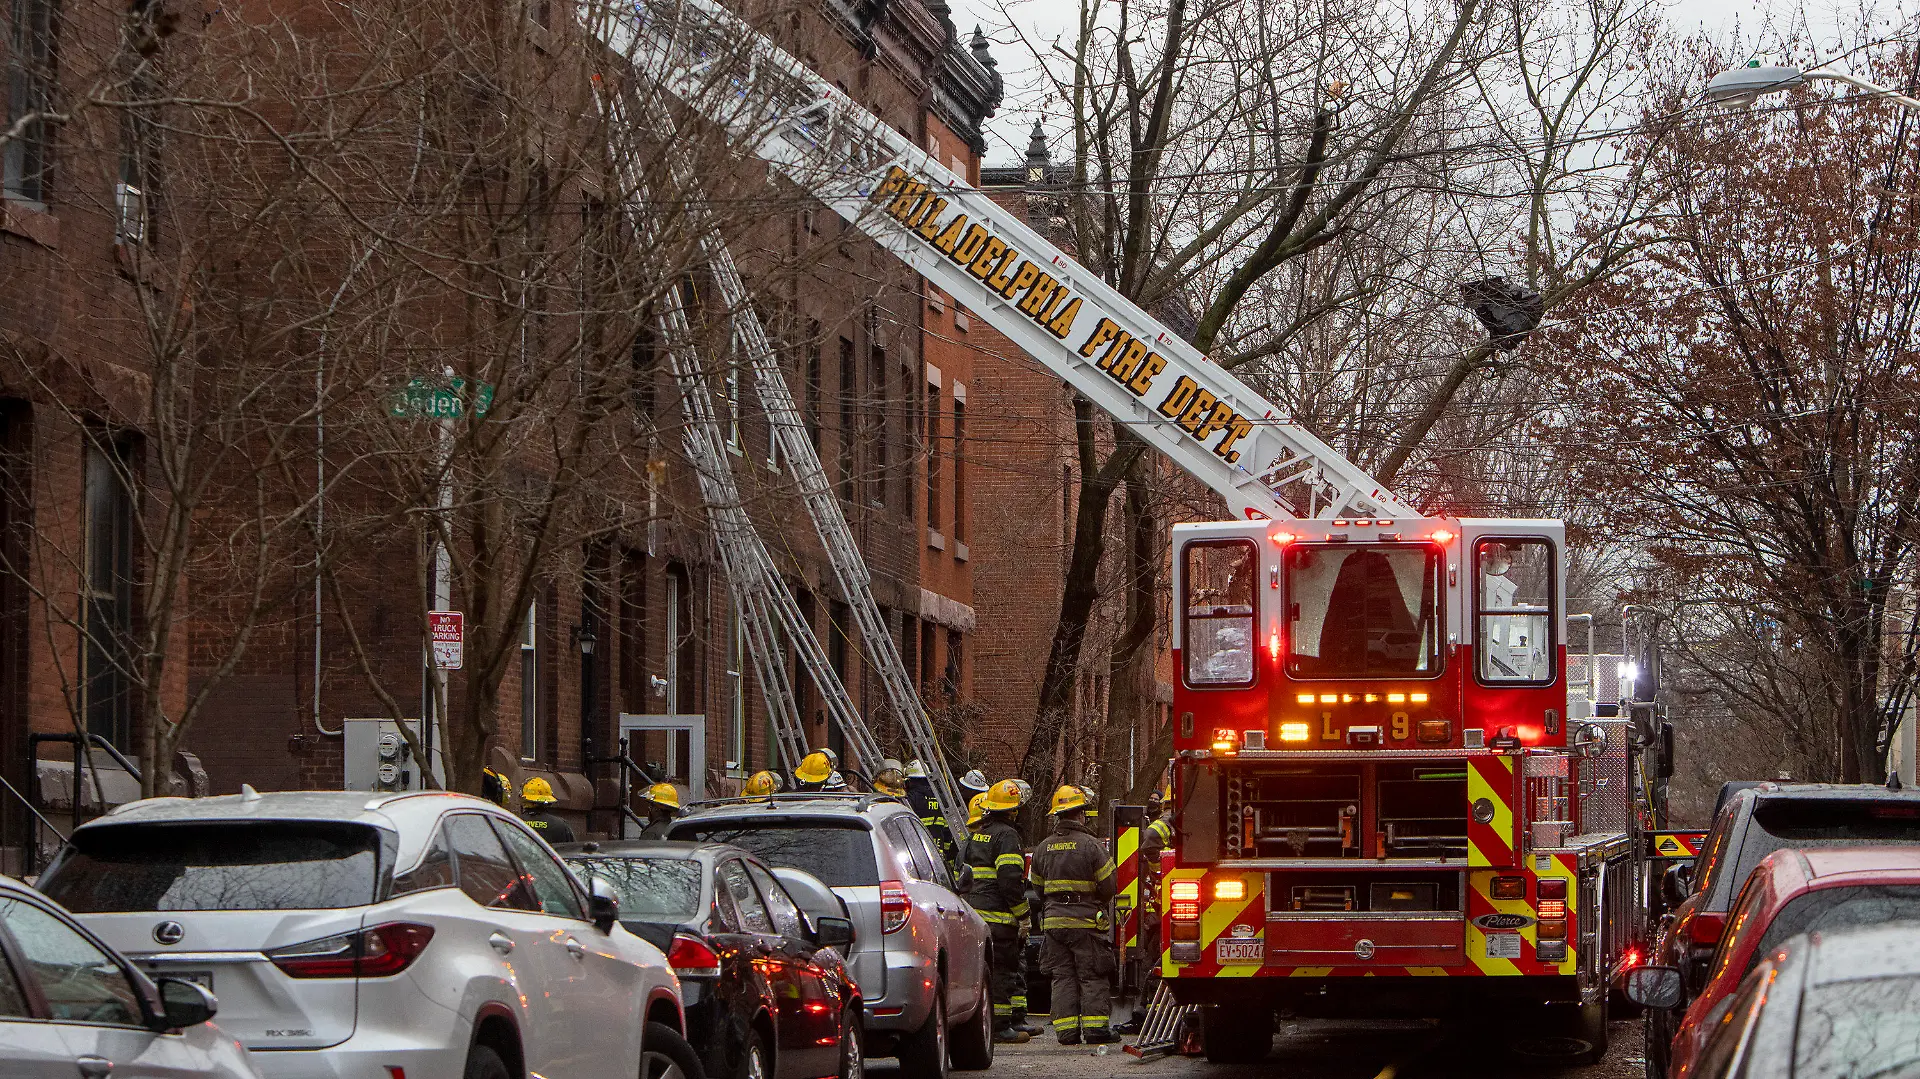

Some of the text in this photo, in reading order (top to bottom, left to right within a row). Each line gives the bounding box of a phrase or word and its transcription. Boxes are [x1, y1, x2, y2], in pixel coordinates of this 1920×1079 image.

[868, 165, 1254, 464] PHILADELPHIA FIRE DEPT.
[1164, 336, 1173, 346] 70
[440, 616, 450, 624] NO
[433, 624, 457, 632] TRUCK
[1322, 711, 1341, 740] L
[1392, 711, 1409, 740] 9
[1485, 914, 1521, 928] Pierce
